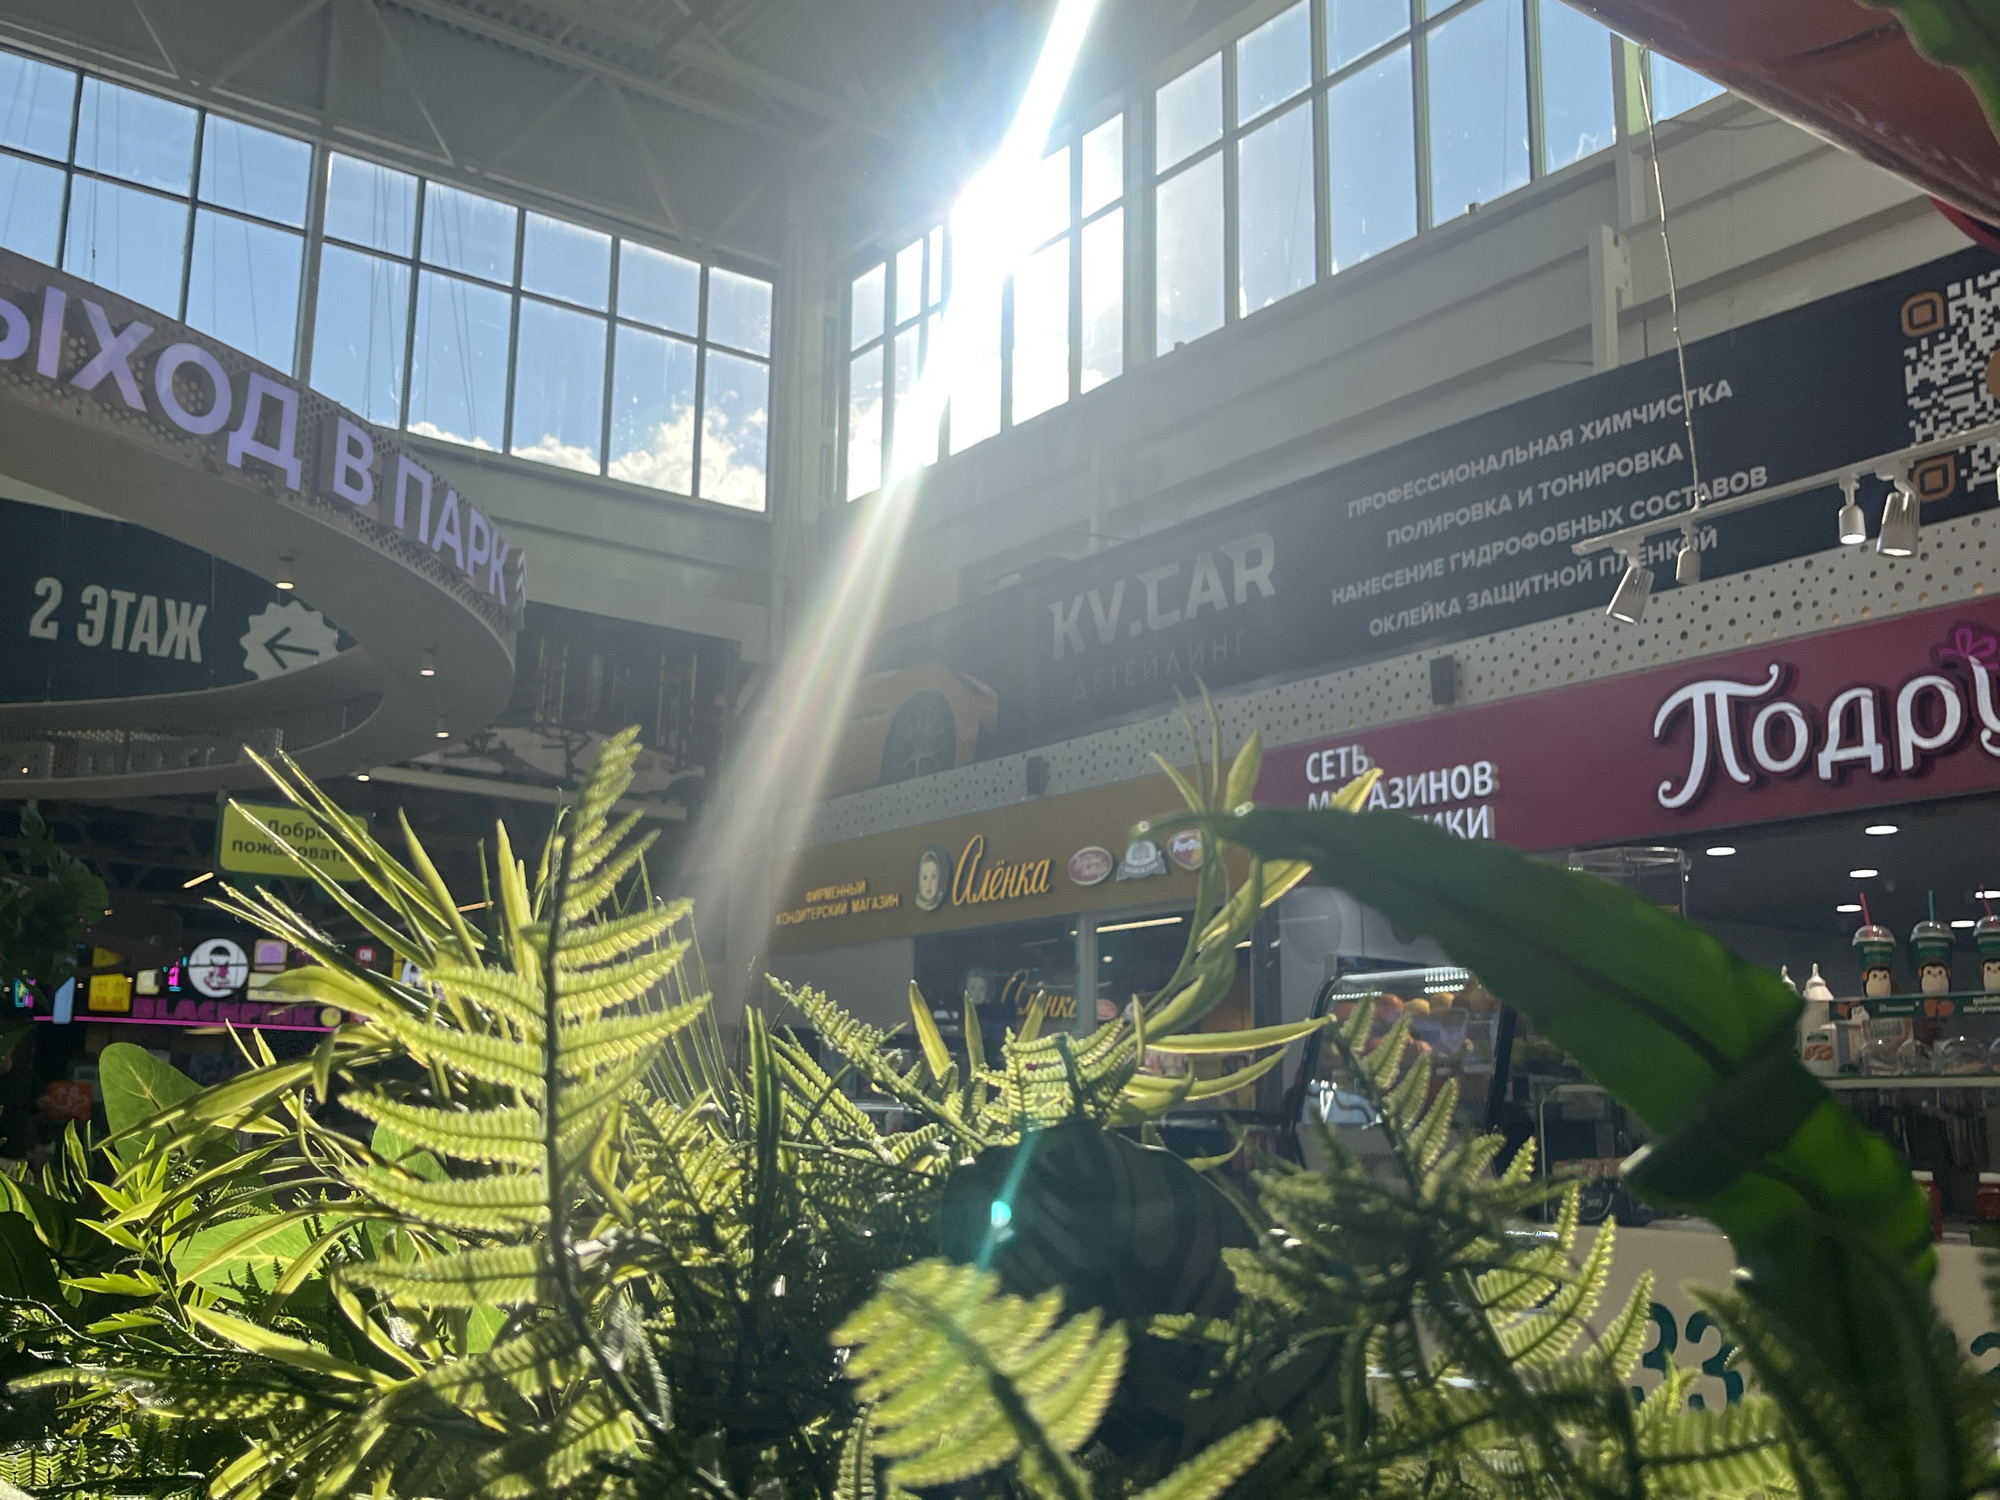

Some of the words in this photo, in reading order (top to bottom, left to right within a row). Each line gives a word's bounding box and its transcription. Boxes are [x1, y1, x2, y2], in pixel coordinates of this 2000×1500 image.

[1347, 426, 1575, 519] ПРОФЕССИОНАЛЬНАЯ
[1578, 378, 1735, 442] ХИМЧИСТКА
[332, 416, 376, 508] В
[393, 455, 510, 606] ПАРК
[1330, 555, 1446, 606] НАНЕСЕНИЕ
[1449, 507, 1625, 572] ГИДРОФОБНЫХ
[1628, 465, 1769, 522] СОСТАВОВ
[1386, 492, 1513, 548] ПОЛИРОВКА
[1516, 486, 1535, 511] И
[1537, 441, 1685, 503] ТОНИРОВКА
[29, 577, 64, 641] 2
[76, 584, 208, 664] ЭТАЖ
[1048, 531, 1276, 660] KV.CAR
[1368, 595, 1463, 638] ОКЛЕЙКА
[1465, 555, 1595, 603] ЗАЩИТНОЙ
[1305, 743, 1373, 785] СЕТЬ
[1307, 759, 1496, 812] МАЗИНОВ
[775, 900, 848, 927] КОНДИТЕРСКИЙ
[851, 893, 900, 915] МАГАЗИН
[806, 878, 866, 904] ФИРМЕННЫЙ
[952, 833, 1052, 908] Алёнка
